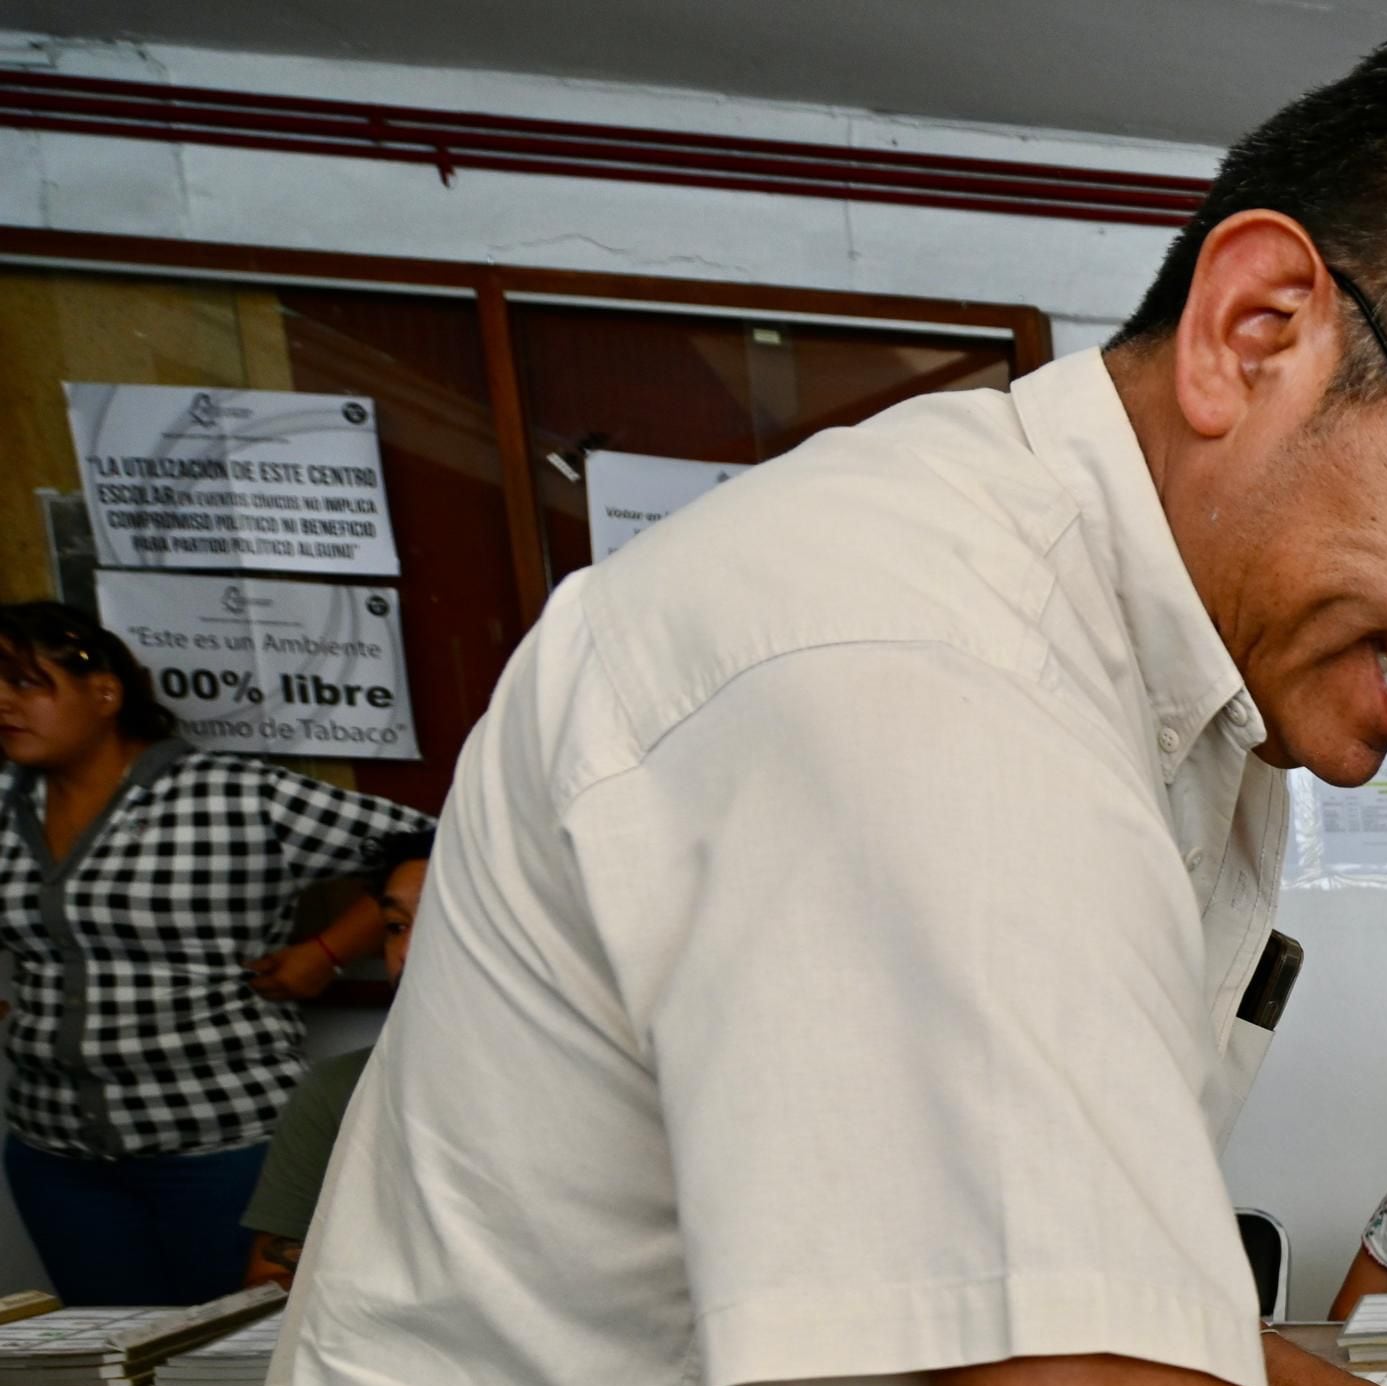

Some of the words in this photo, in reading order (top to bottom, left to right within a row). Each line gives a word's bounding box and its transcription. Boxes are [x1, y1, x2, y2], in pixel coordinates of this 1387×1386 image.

[230, 461, 257, 484] DE
[259, 462, 304, 486] ESTE
[307, 463, 378, 488] CENTRO
[193, 634, 219, 651] es
[223, 635, 253, 652] un
[262, 632, 383, 659] Ambiente
[280, 672, 394, 709] libre
[257, 716, 295, 741] de
